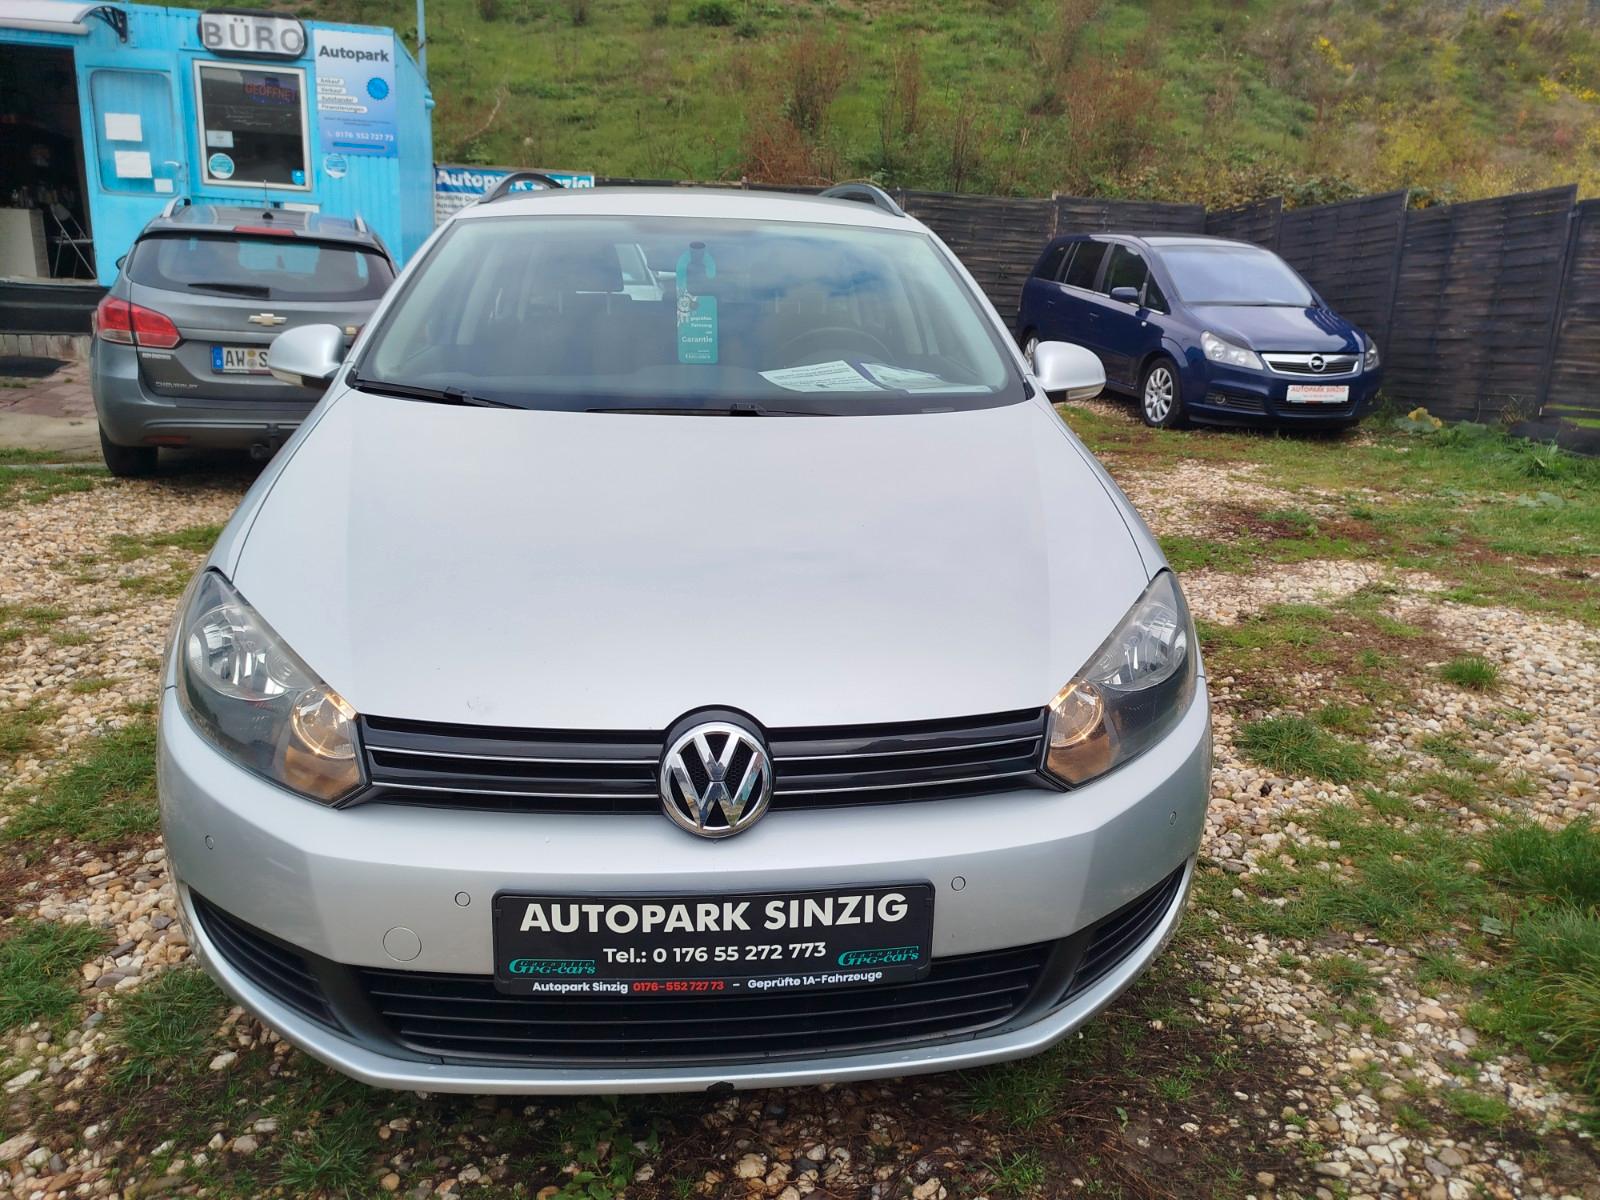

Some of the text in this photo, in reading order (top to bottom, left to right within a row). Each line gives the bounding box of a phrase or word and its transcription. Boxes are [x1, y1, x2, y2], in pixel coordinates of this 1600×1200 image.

[203, 17, 304, 53] BÜRO
[318, 45, 389, 62] Autopark
[225, 350, 268, 367] AW S
[520, 893, 908, 934] AUTOPARK SINZIG
[603, 942, 826, 963] Tel.: 0 176 55 272 773
[532, 981, 590, 994] Autopark
[592, 981, 629, 994] Sinzig
[747, 975, 801, 990] Geprüfte
[803, 970, 883, 986] 1A-Fahrzeuge
